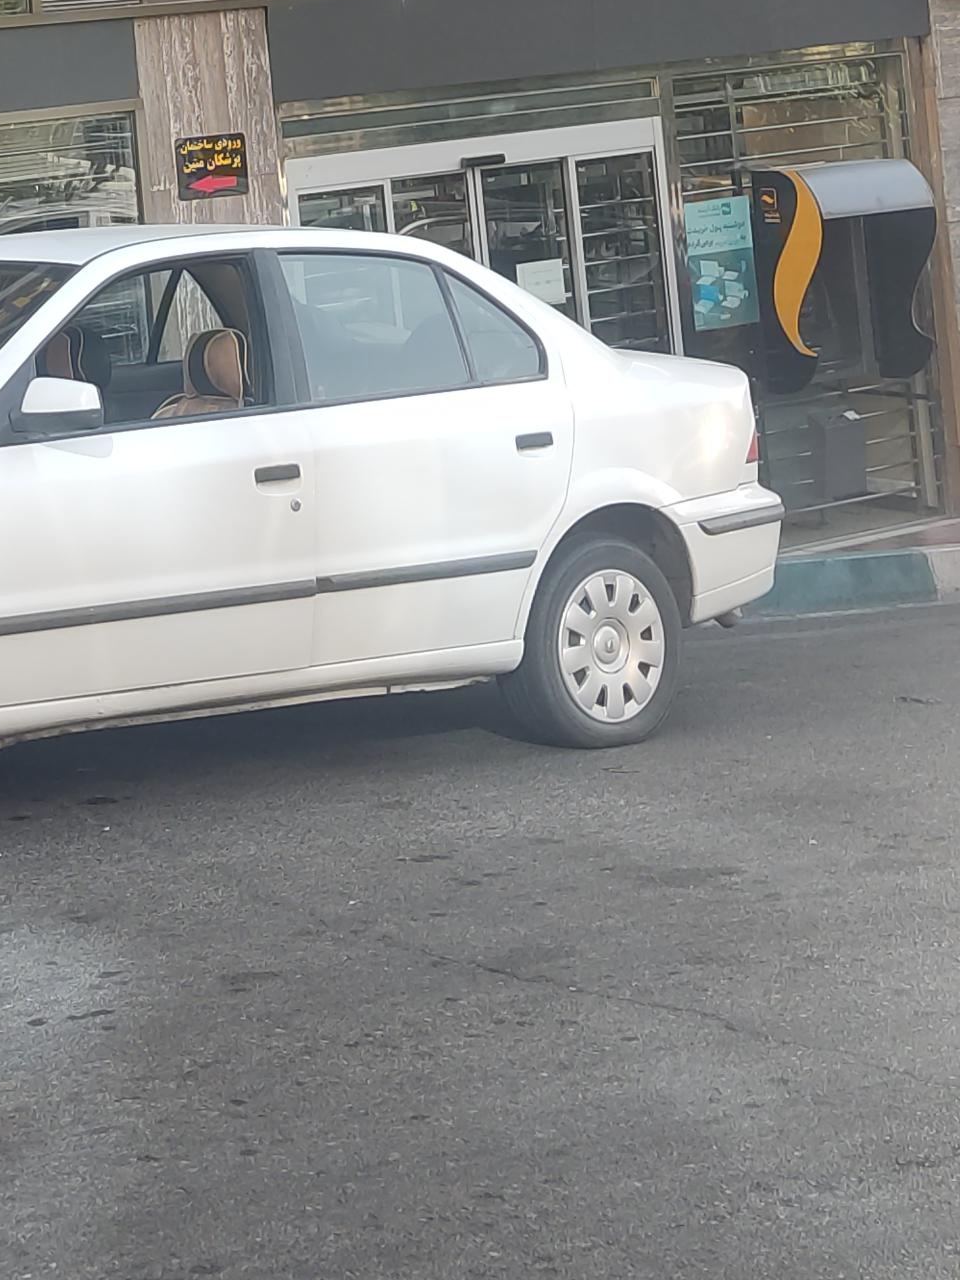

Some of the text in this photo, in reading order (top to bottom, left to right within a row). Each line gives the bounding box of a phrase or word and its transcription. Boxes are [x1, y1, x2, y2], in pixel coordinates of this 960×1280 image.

[180, 137, 242, 155] ورودی ساختمان
[183, 152, 242, 174] پزشکان متین
